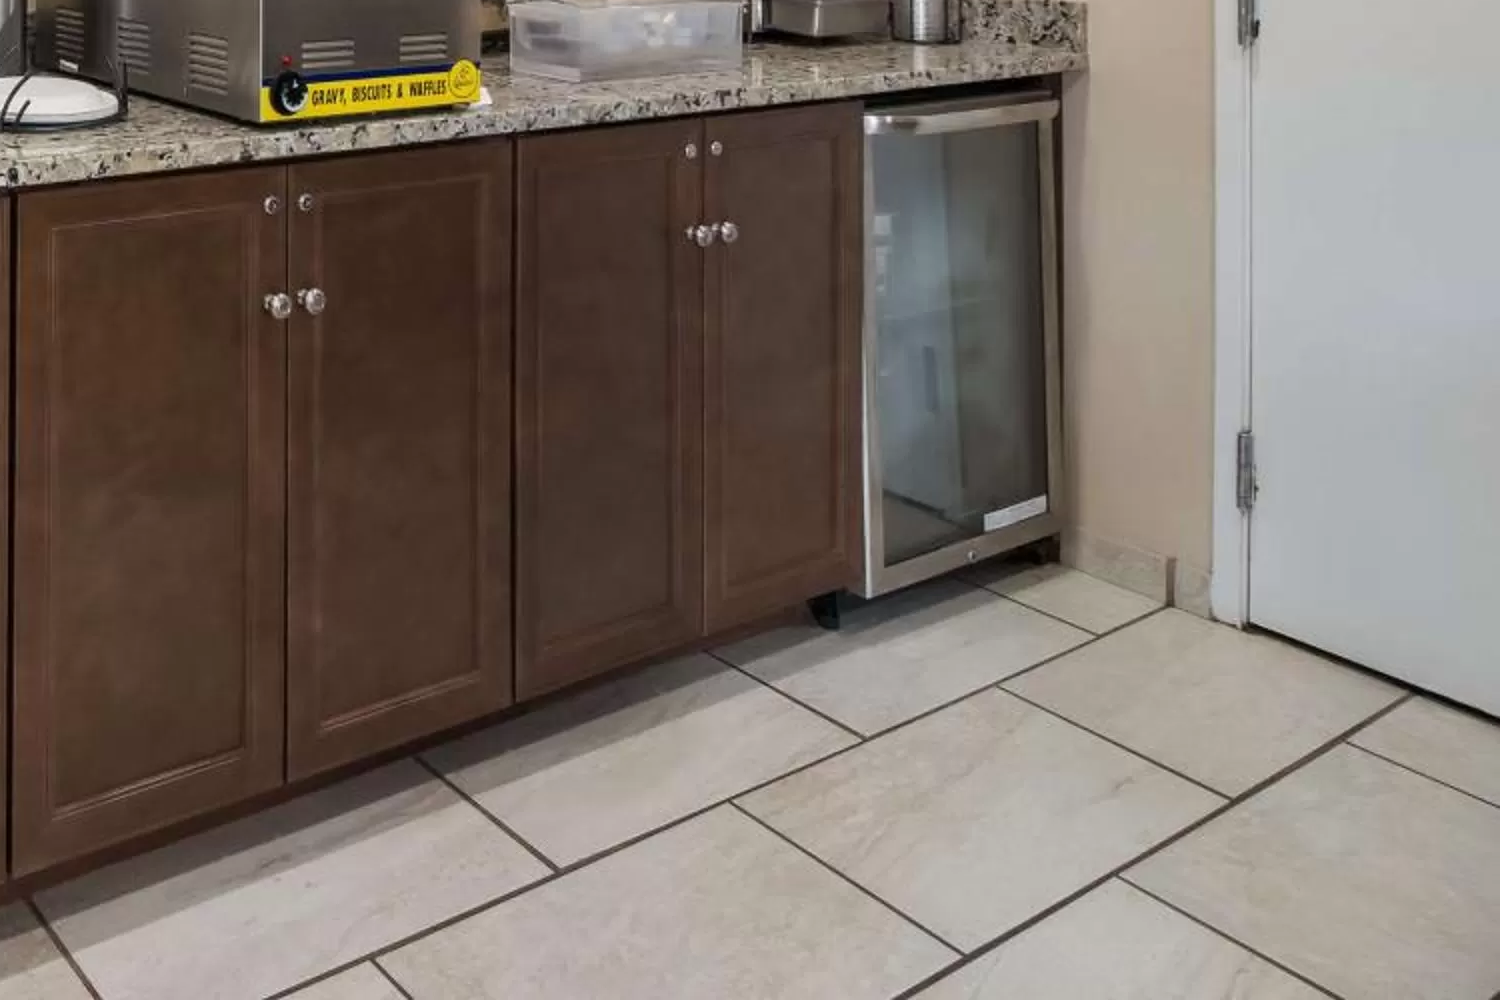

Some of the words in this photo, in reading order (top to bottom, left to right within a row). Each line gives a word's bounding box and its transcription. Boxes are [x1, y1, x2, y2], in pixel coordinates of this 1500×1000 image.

[312, 87, 347, 107] GRAVY,
[352, 83, 391, 102] BISCUITS
[396, 82, 403, 98] &
[409, 80, 446, 96] WAFFLES
